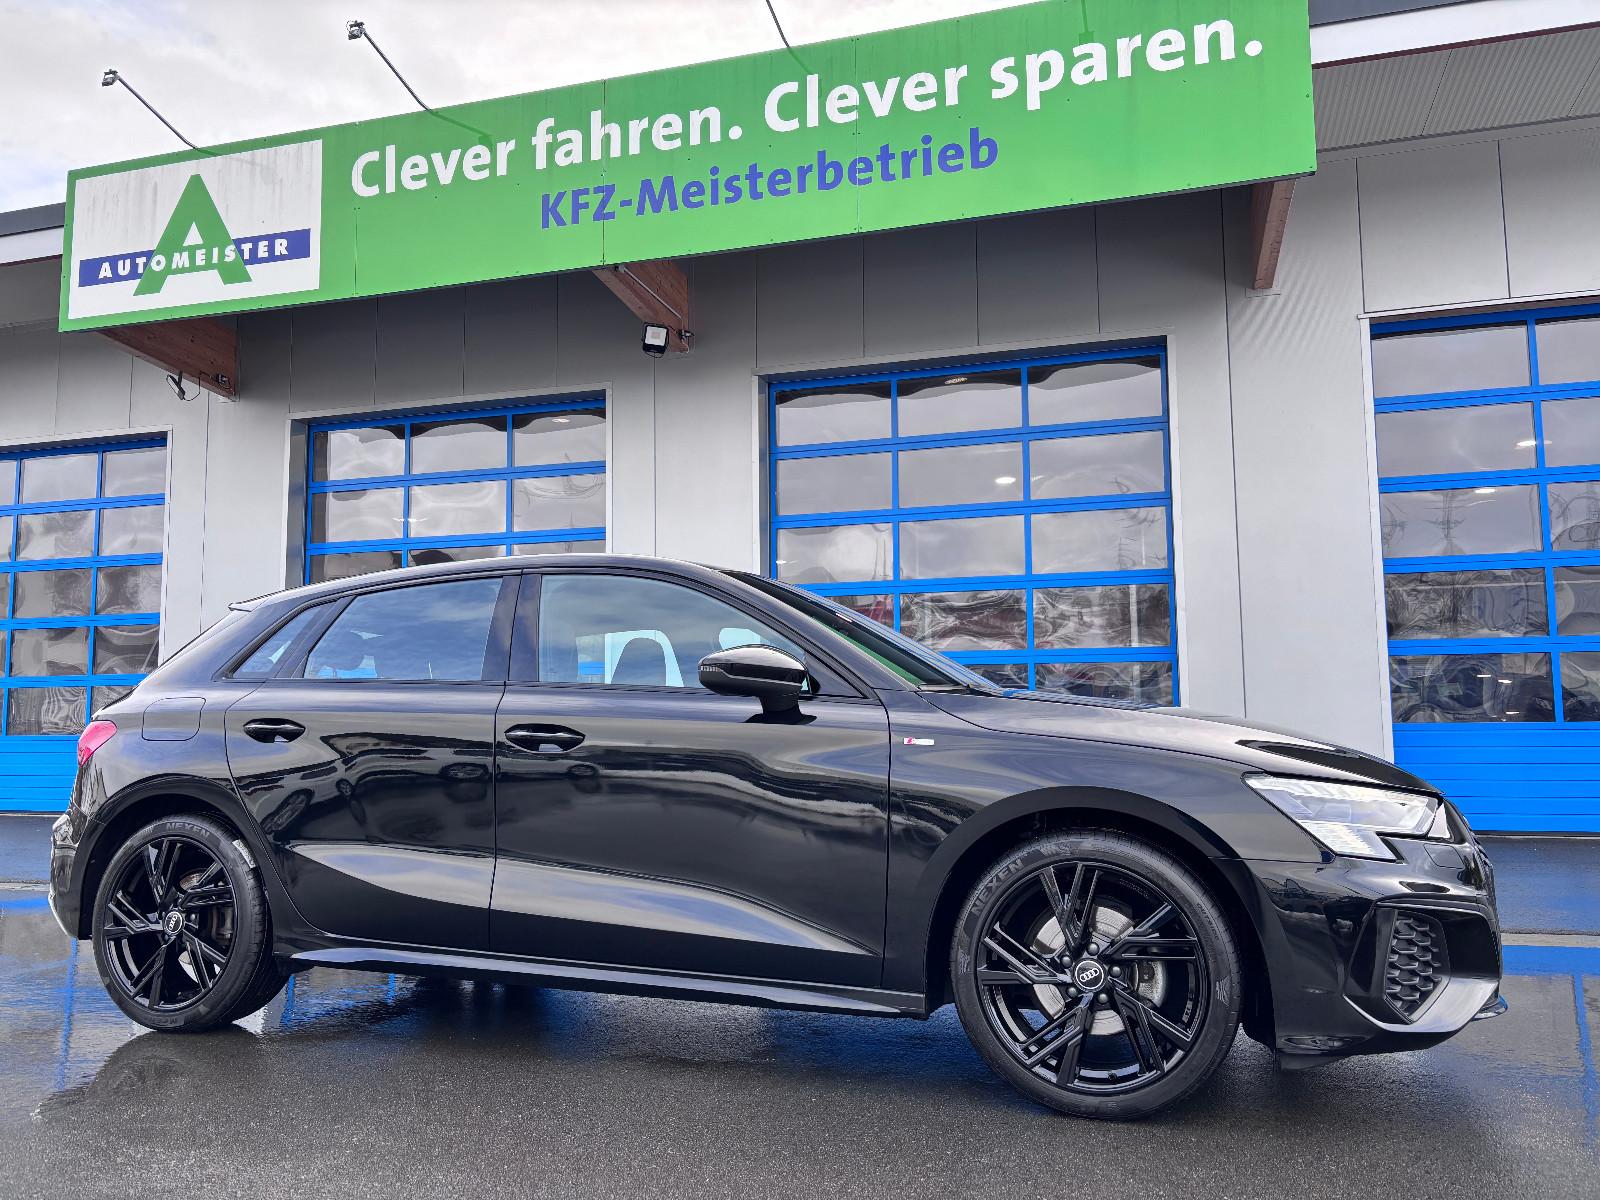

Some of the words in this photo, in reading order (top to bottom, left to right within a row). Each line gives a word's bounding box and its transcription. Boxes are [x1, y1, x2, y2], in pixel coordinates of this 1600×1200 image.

[352, 139, 516, 197] Clever
[532, 109, 743, 170] fahren.
[765, 64, 968, 133] Clever
[991, 19, 1263, 111] sparen.
[541, 127, 998, 230] KFZ-Meisterbetrieb
[98, 238, 289, 279] AUTOMEISTER
[166, 821, 211, 838] NEXEN
[970, 858, 1025, 917] NEXEN
